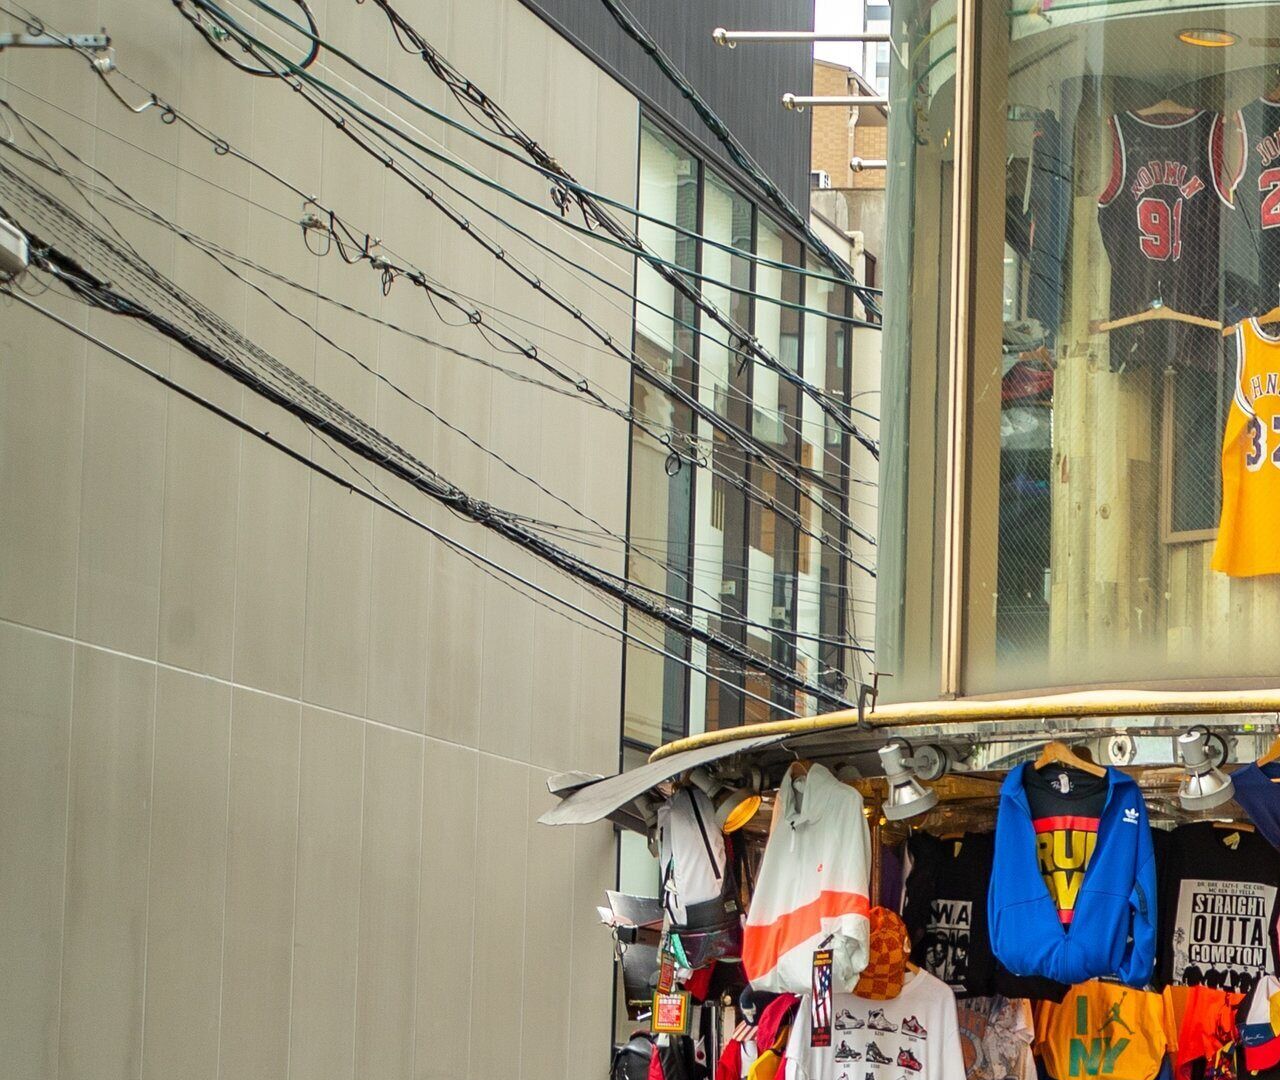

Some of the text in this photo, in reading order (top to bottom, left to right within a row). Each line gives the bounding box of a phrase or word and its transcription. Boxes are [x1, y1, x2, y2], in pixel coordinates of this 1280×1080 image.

[1195, 894, 1265, 916] STRAIGHT
[1193, 914, 1263, 946] OUTTA
[1191, 945, 1264, 965] COMPTON
[1069, 1037, 1130, 1077] NY
